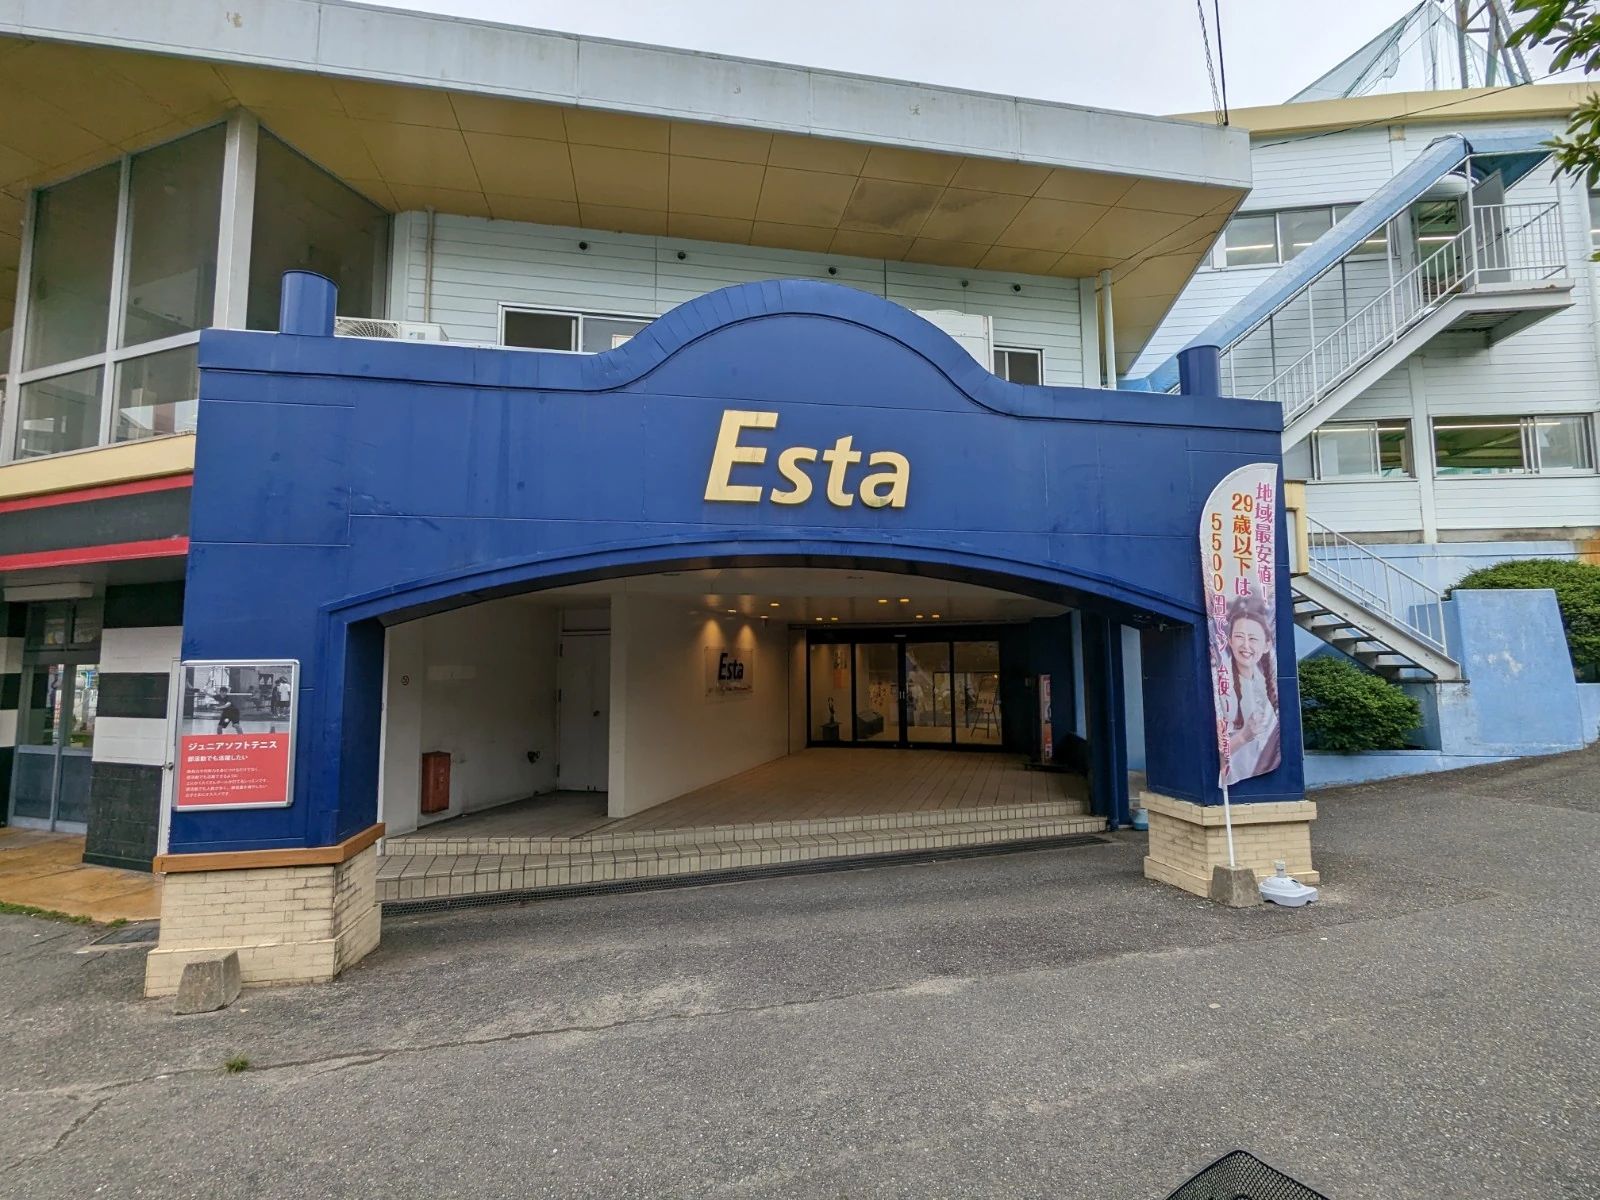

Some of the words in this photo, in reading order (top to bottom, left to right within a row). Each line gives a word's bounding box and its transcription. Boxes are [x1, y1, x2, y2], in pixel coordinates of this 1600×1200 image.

[704, 410, 910, 508] Esta
[1231, 493, 1253, 597] 29歳以下は
[718, 653, 744, 680] Esta
[188, 740, 277, 751] ジュニアソフトテニス
